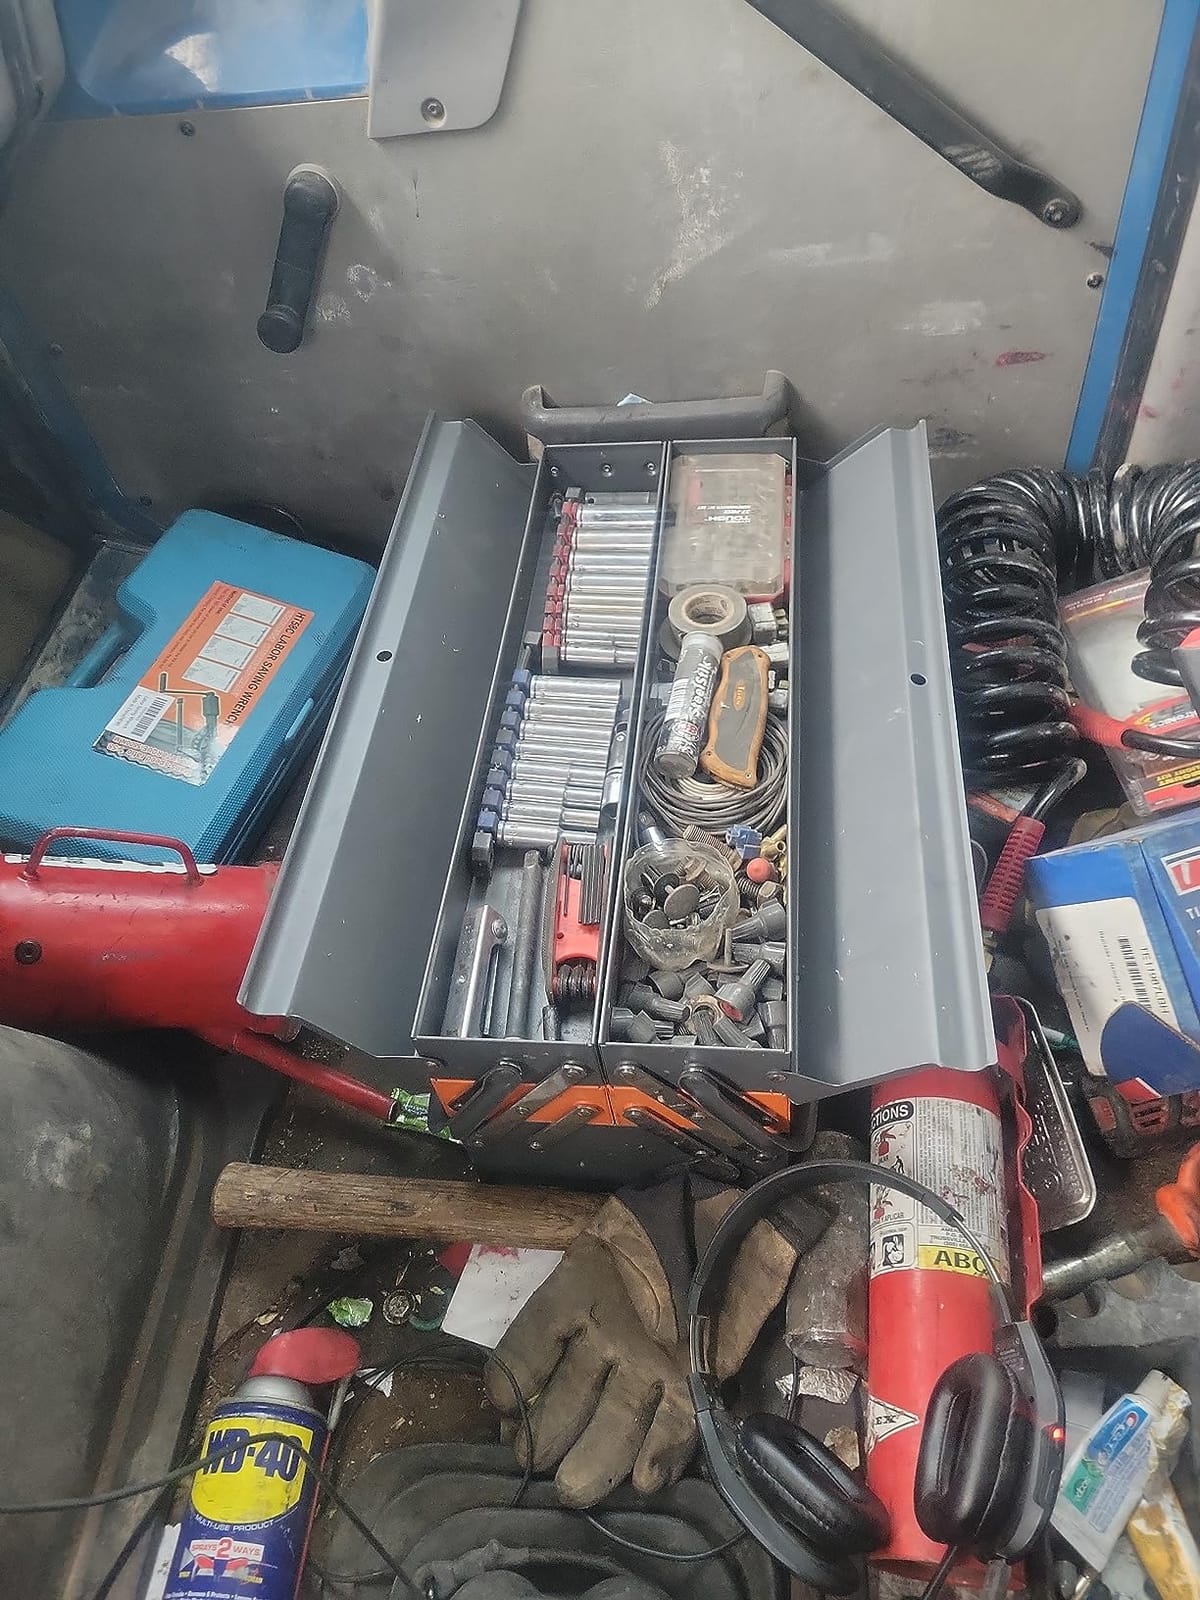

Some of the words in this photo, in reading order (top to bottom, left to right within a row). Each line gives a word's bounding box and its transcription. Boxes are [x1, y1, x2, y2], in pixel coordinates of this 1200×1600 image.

[271, 633, 291, 662] LABOR
[248, 660, 272, 692] SAVING
[688, 657, 713, 717] SteelStik
[223, 692, 253, 727] WRENCH
[202, 1428, 303, 1481] WD-40
[195, 1514, 230, 1532] MULTI-USE
[233, 1520, 274, 1532] PRODUCT
[191, 1543, 218, 1551] SPRAYS
[216, 1538, 233, 1558] 2
[233, 1545, 261, 1556] WAYS
